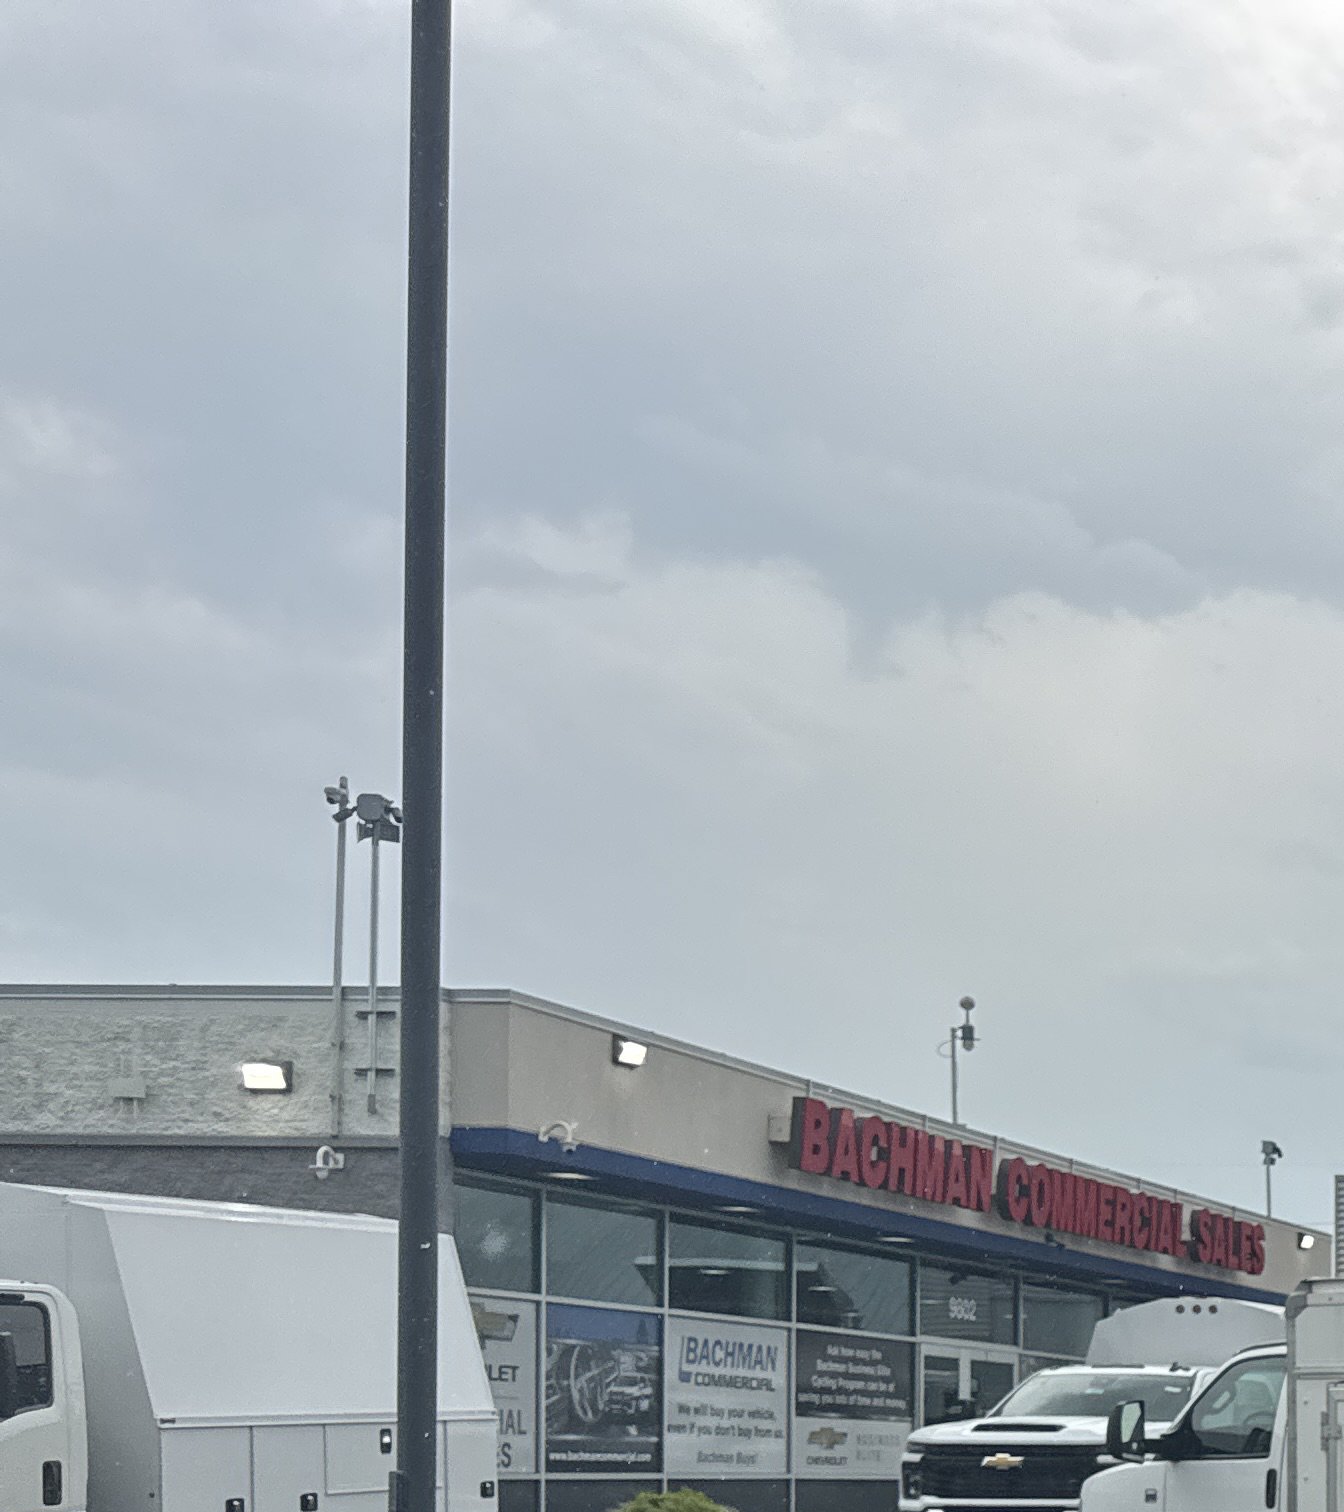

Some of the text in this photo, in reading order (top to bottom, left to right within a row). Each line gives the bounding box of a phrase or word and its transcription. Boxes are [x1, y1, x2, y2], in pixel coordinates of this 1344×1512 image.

[799, 1097, 1266, 1275] BACHMAN COMMERCIAL SALES
[685, 1336, 778, 1372] BACHMAN
[694, 1371, 776, 1392] COMMERCIAL
[693, 1402, 708, 1416] will
[710, 1404, 725, 1420] buy
[727, 1407, 746, 1420] your
[688, 1421, 695, 1434] if
[697, 1425, 713, 1438] you
[737, 1425, 752, 1440] buy
[754, 1425, 773, 1438] from
